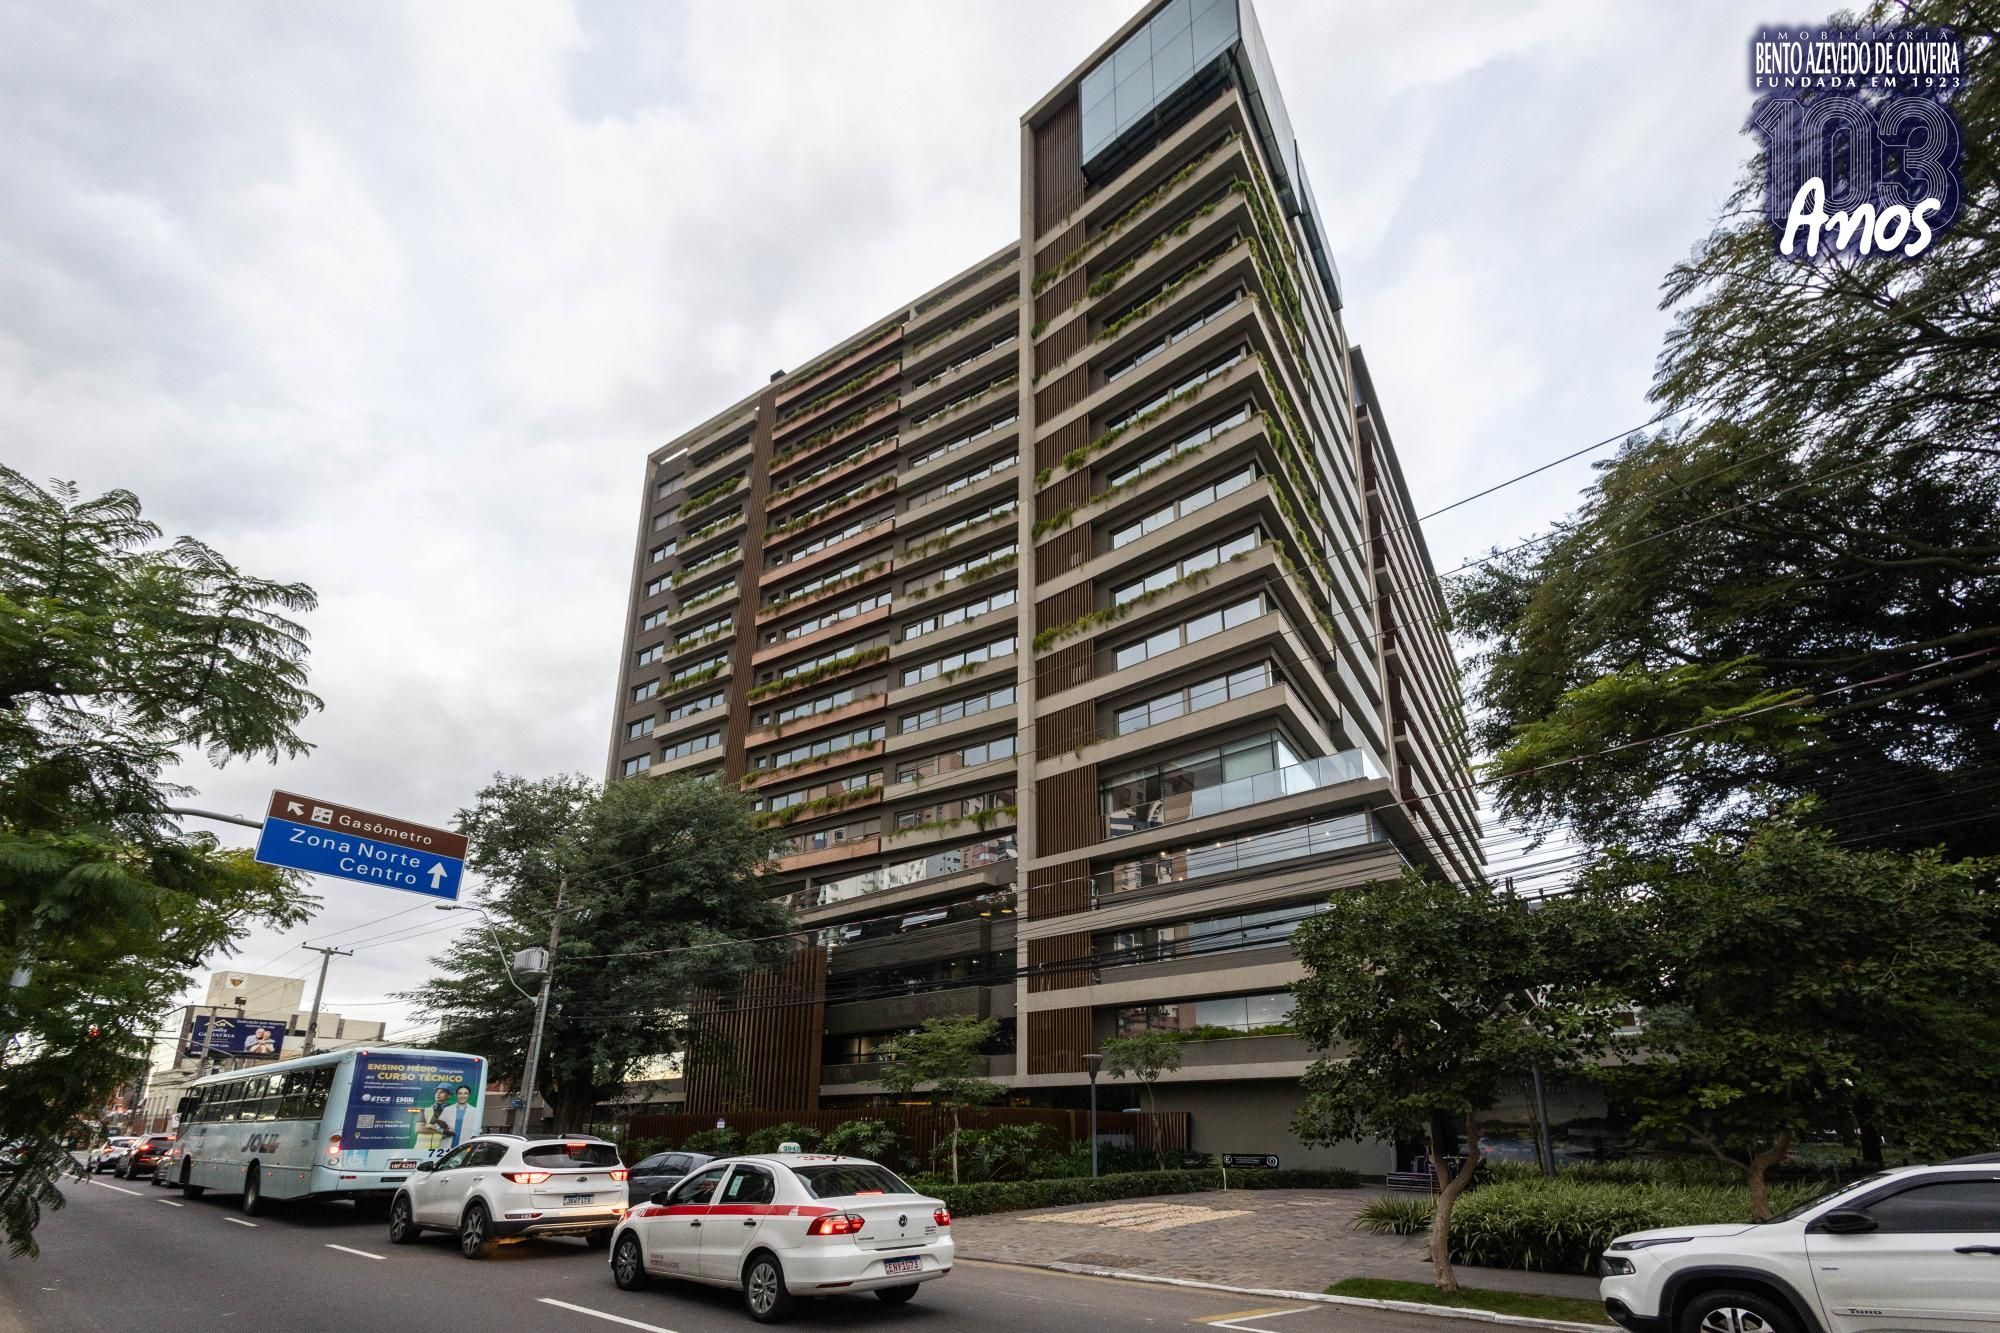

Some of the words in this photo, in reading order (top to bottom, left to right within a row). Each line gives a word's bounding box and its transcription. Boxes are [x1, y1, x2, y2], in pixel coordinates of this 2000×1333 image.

[338, 814, 432, 845] Gasômetro
[289, 827, 350, 854] Zona
[357, 842, 421, 869] Norte
[339, 857, 417, 885] Centro
[367, 1063, 405, 1072] ENSINO
[406, 1063, 438, 1073] MÉDIO
[377, 1072, 416, 1081] CURSO
[418, 1072, 463, 1083] TÉCNICO
